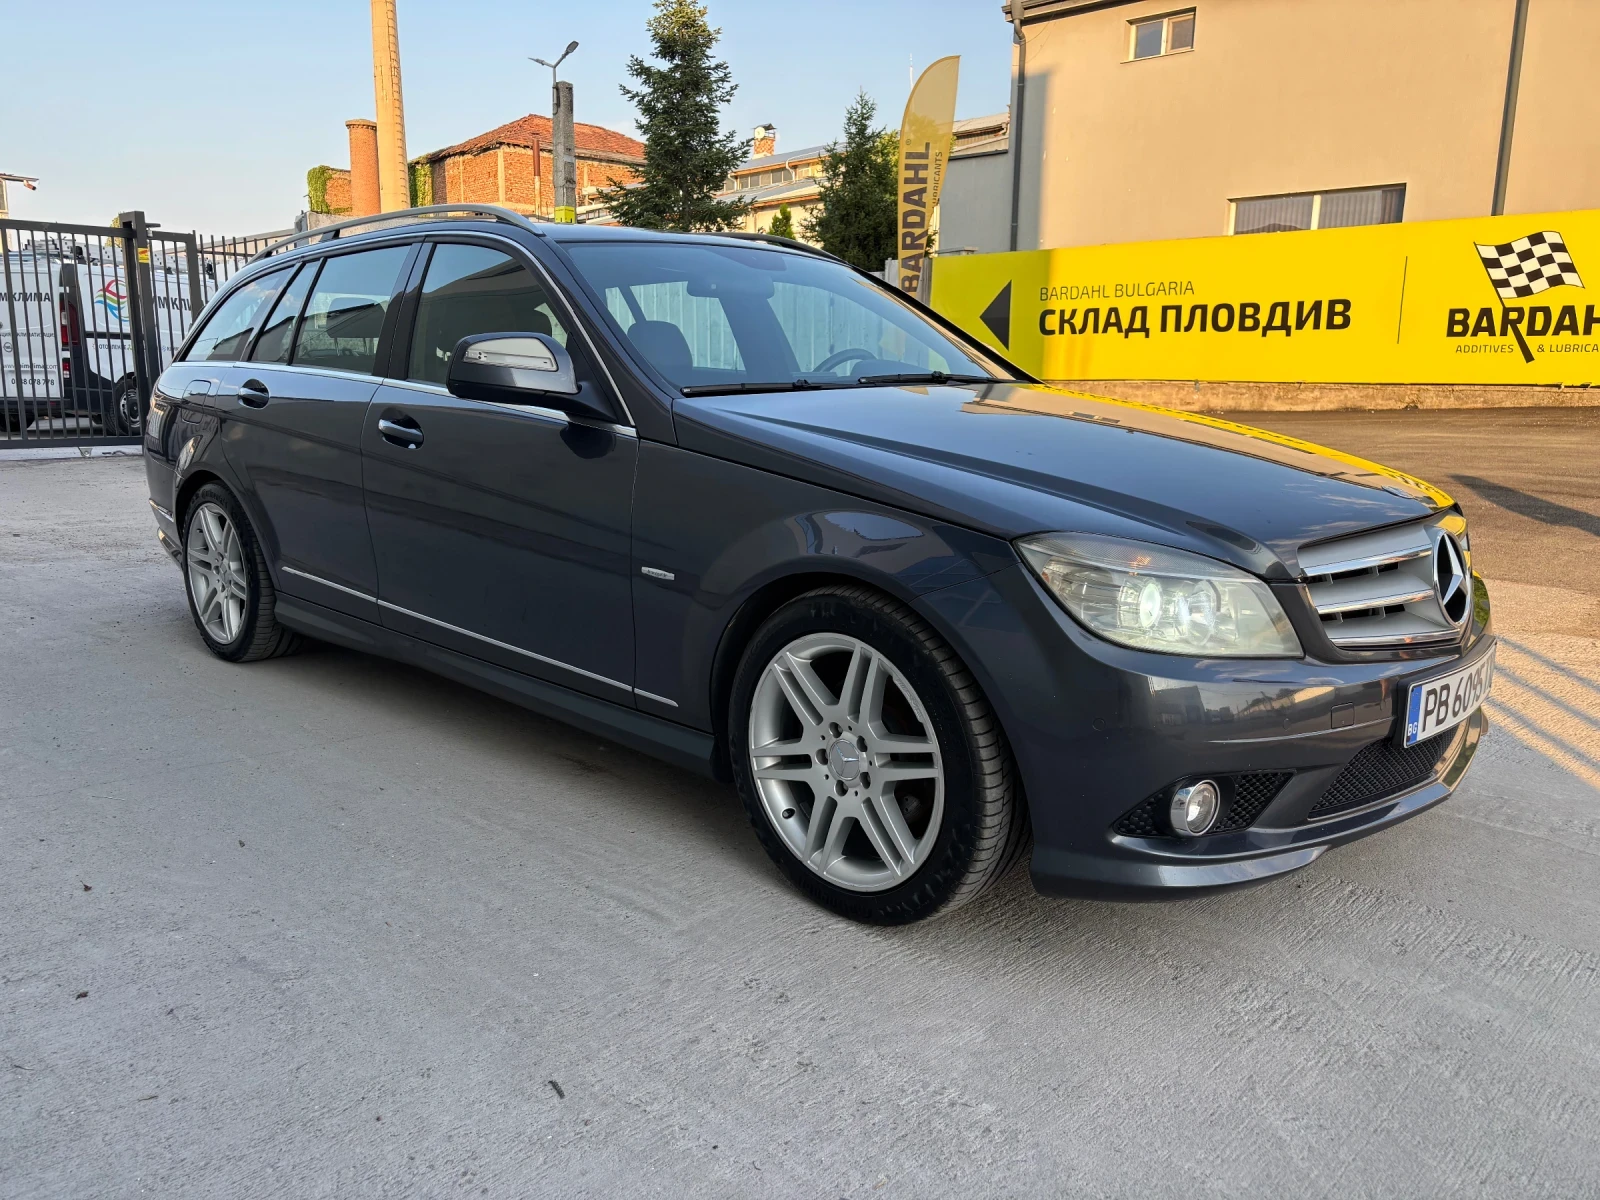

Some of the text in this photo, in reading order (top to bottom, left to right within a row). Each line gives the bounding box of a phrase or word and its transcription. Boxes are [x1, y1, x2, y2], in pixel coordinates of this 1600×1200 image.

[932, 151, 943, 208] UBRICANTS
[901, 141, 931, 293] BARDAHL
[1039, 280, 1195, 302] BARDAHL BULGARIA
[1038, 298, 1352, 339] СКЛАД ПЛОВДИВ
[1455, 344, 1515, 354] ADDITIVES
[1536, 344, 1546, 353] &
[1407, 721, 1418, 736] BG
